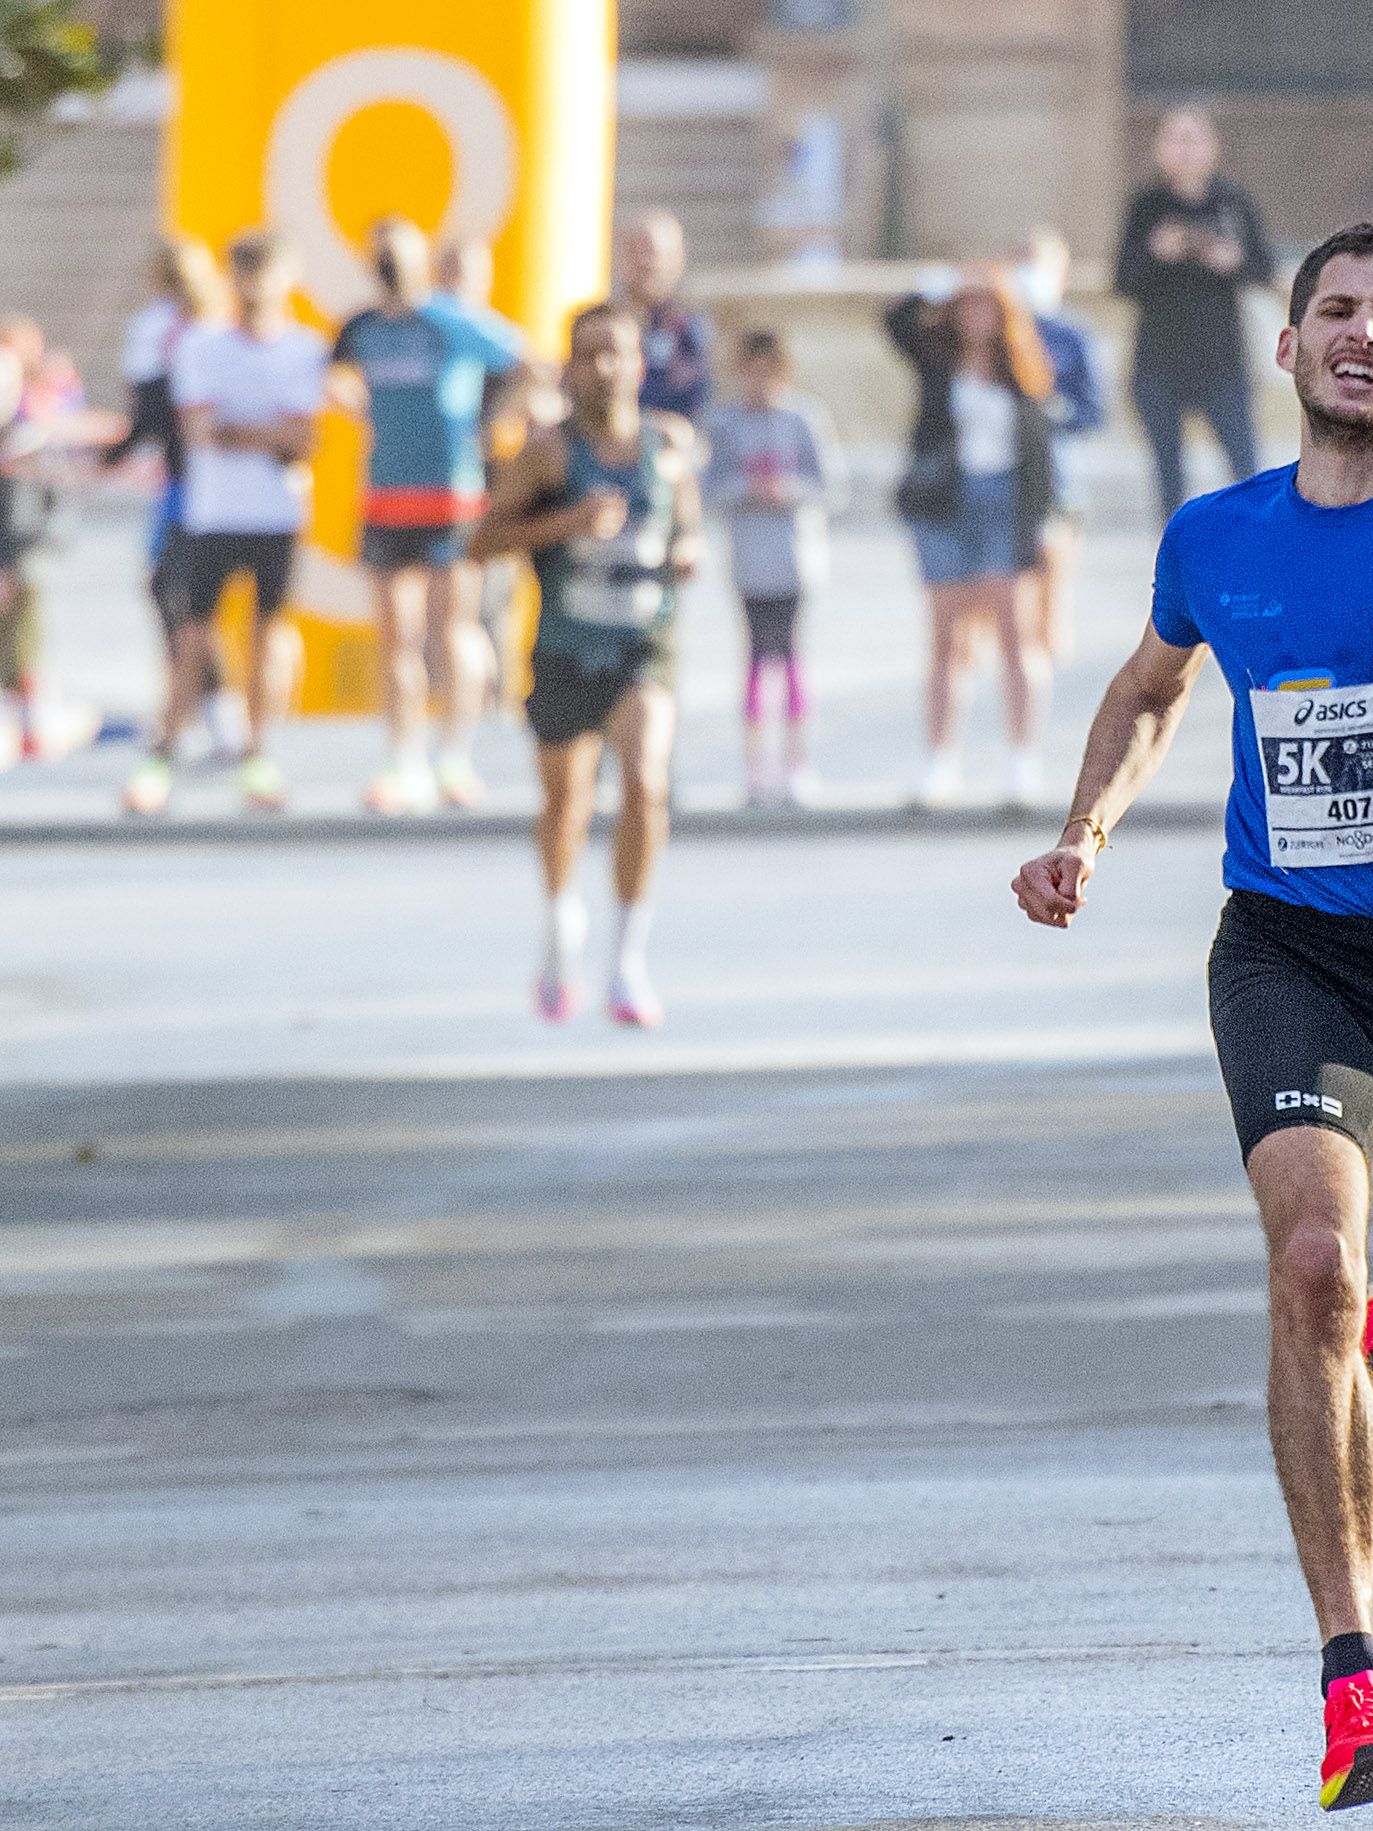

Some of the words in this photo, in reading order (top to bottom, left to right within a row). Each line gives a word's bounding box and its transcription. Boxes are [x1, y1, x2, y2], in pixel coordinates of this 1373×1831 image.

[1316, 699, 1367, 721] asics
[1277, 740, 1331, 785] 5K
[1327, 797, 1371, 821] 407
